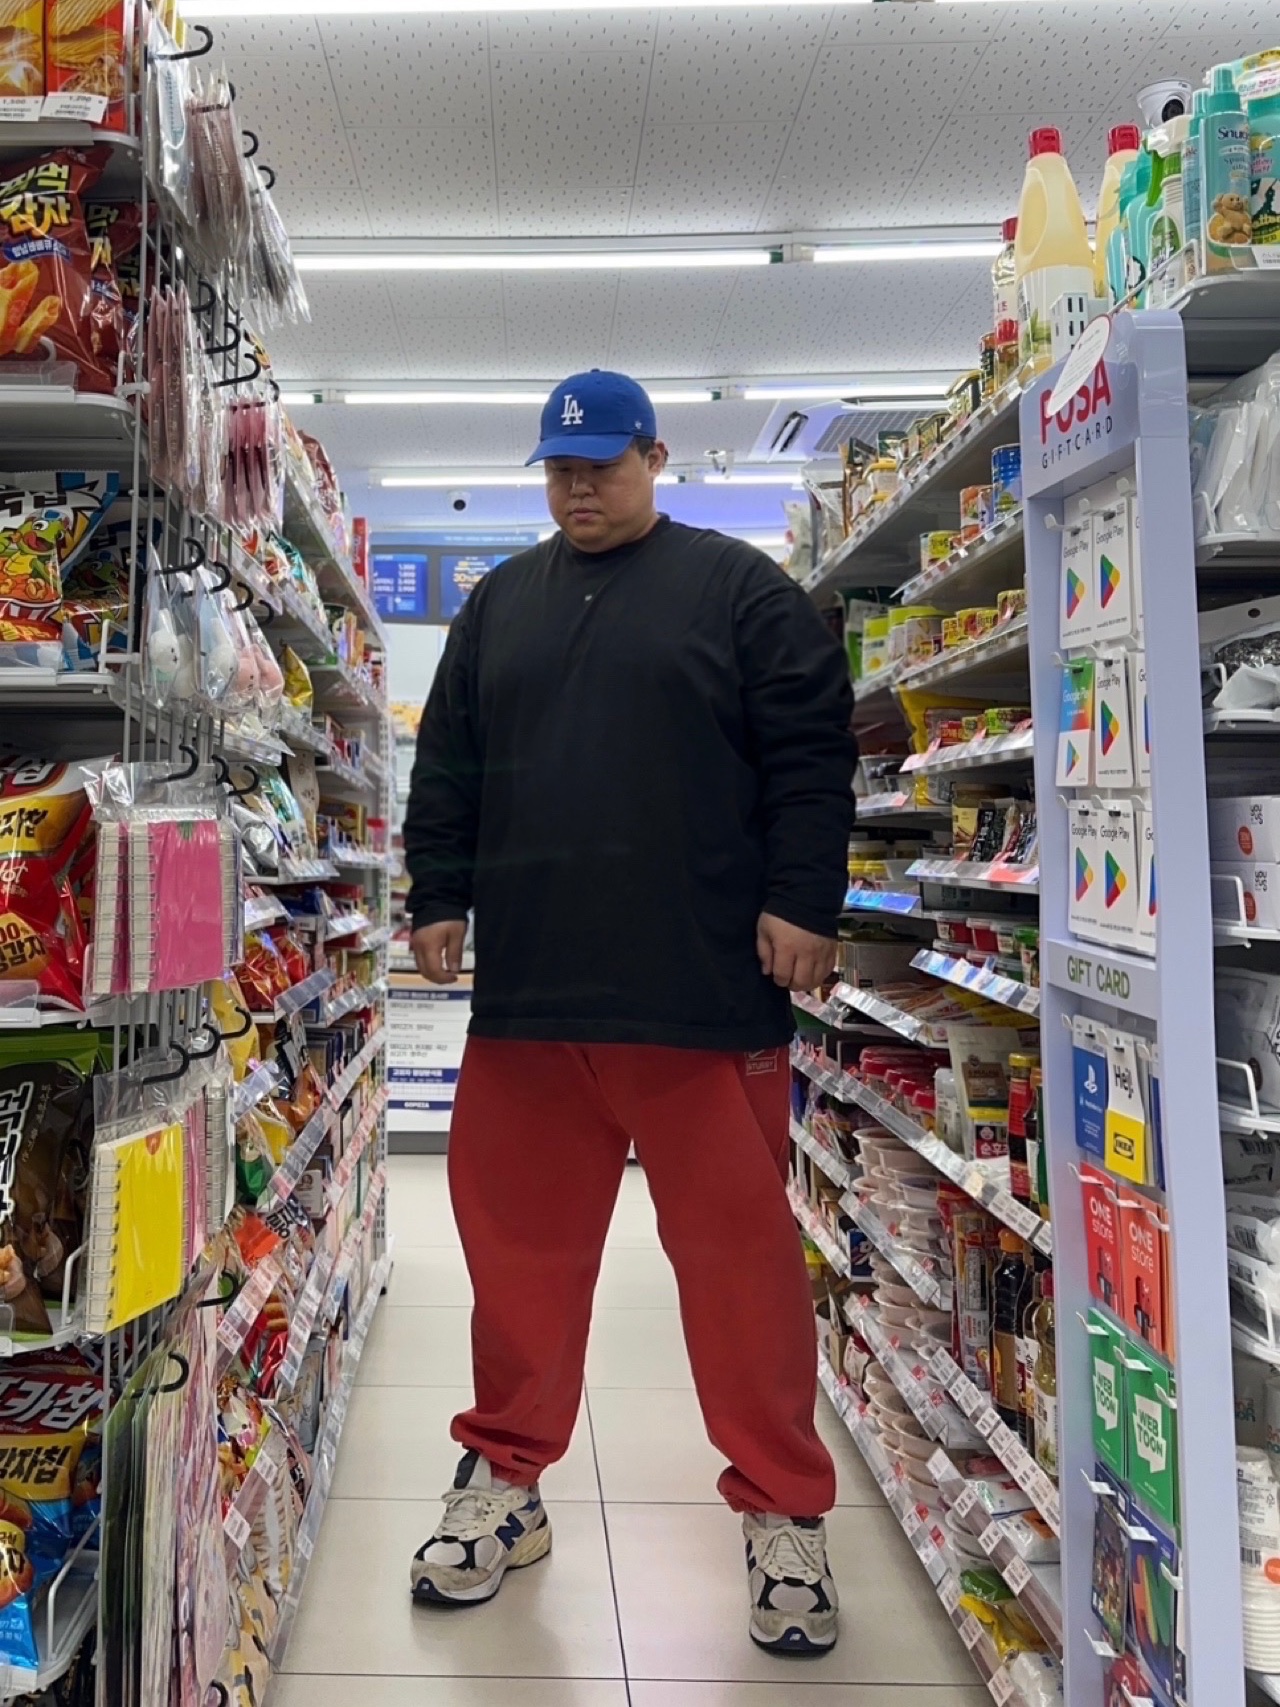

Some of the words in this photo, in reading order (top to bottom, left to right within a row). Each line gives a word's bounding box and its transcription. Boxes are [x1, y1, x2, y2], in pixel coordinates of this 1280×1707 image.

[561, 394, 584, 426] LA
[1096, 530, 1112, 545] Google
[1112, 525, 1124, 539] Play
[1063, 543, 1079, 559] Google
[1097, 675, 1112, 691] Google
[1112, 673, 1121, 688] Play
[1071, 823, 1087, 838] Google
[1088, 826, 1097, 839] Play
[1100, 825, 1118, 840] Google
[1118, 826, 1130, 842] Play
[1068, 955, 1092, 987] GIFT
[1096, 964, 1130, 999] CARD
[1115, 1138, 1132, 1153] IKEA
[1090, 1196, 1112, 1226] ONE
[1092, 1220, 1114, 1245] store
[1129, 1222, 1153, 1253] ONE
[1131, 1244, 1154, 1274] store
[1097, 1373, 1113, 1396] WEB
[1096, 1385, 1116, 1415] TOON
[1138, 1410, 1159, 1438] WEB
[1137, 1424, 1163, 1456] TOON
